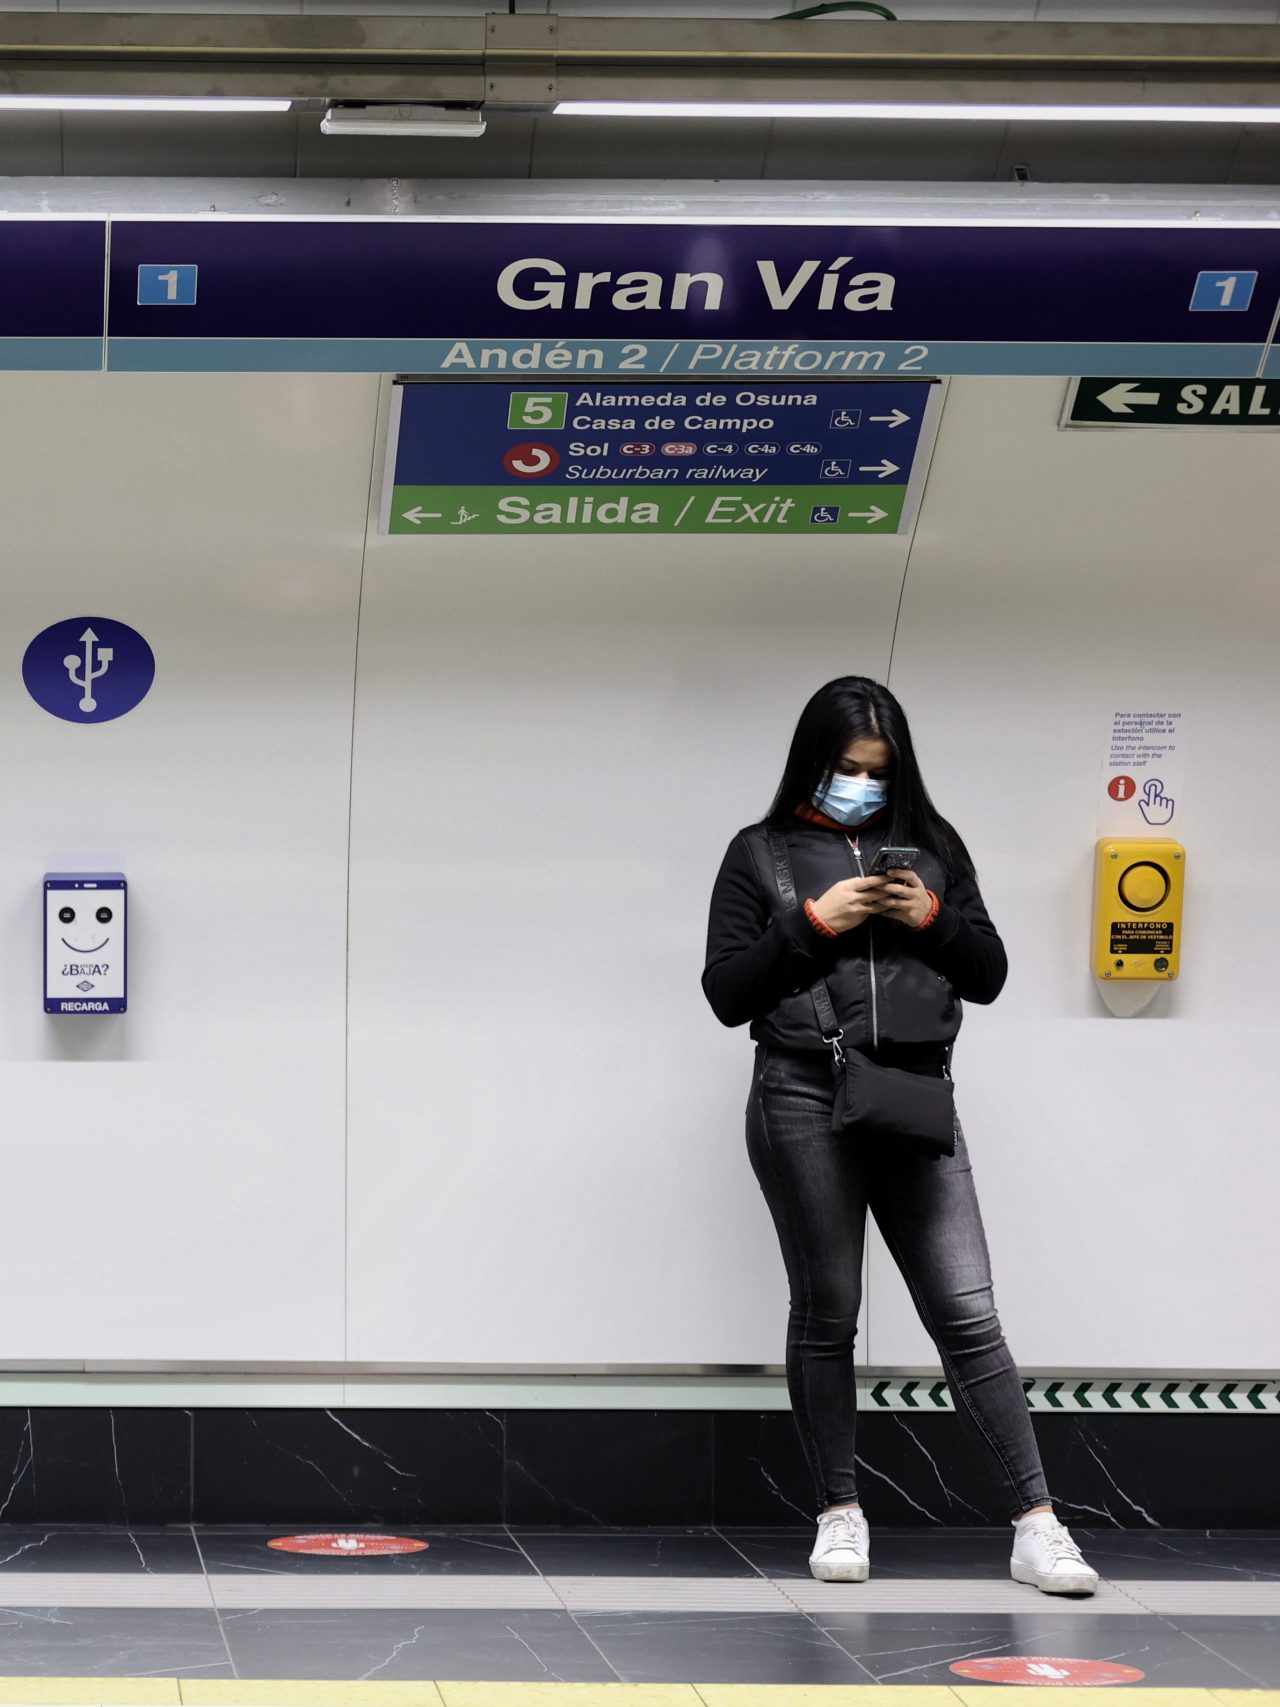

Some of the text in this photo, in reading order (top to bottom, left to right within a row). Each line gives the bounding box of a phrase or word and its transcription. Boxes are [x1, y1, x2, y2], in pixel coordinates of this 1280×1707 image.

[158, 270, 178, 300] 1
[496, 256, 897, 312] Gran Vía
[1215, 276, 1238, 306] 1
[440, 341, 929, 373] Andén 2 / Platform 2
[522, 397, 553, 425] 5
[575, 391, 818, 407] Alameda de Osuna
[1176, 384, 1280, 415] SAL
[572, 415, 775, 433] Casa de Campo
[568, 442, 819, 457] Sol C-3 C-3a C-4 C-4a C-4b
[565, 465, 769, 482] Suburban railway
[496, 495, 796, 526] Salida / Exit
[60, 1002, 110, 1012] RECARGA
